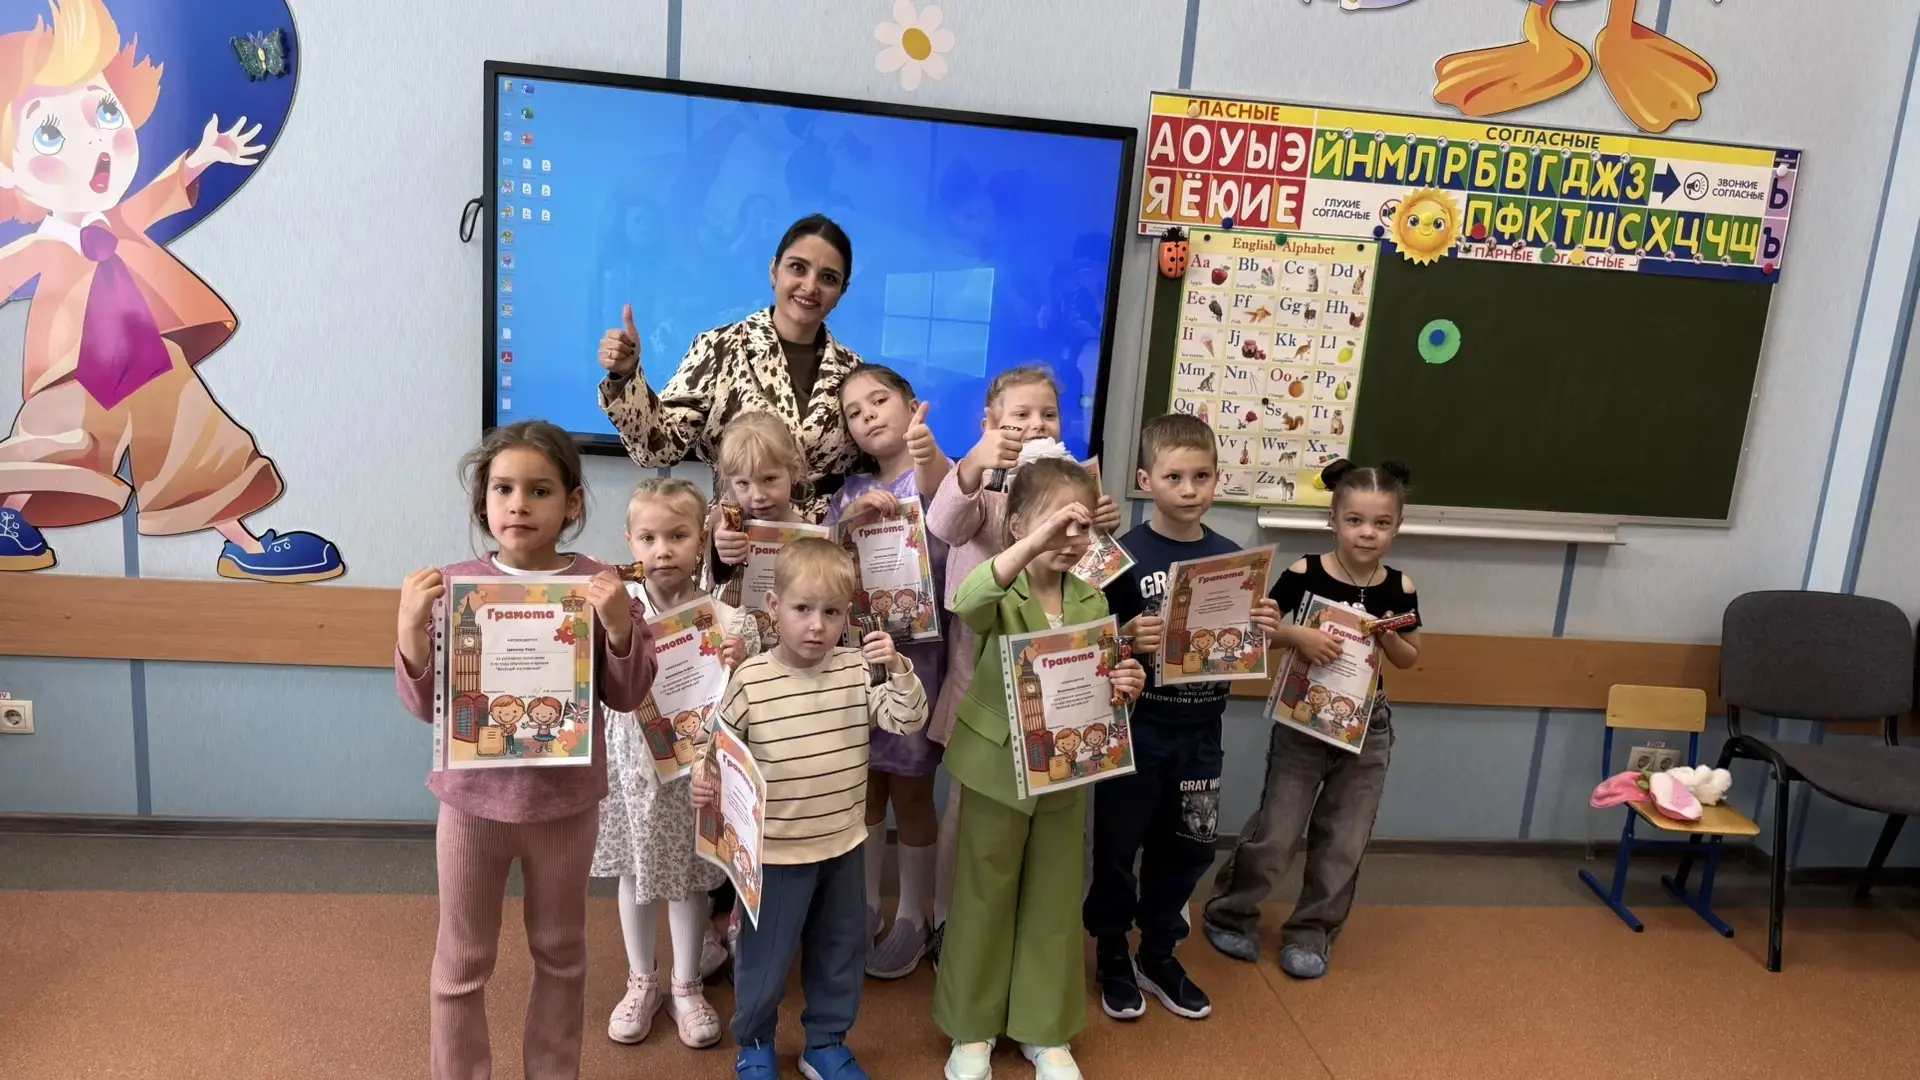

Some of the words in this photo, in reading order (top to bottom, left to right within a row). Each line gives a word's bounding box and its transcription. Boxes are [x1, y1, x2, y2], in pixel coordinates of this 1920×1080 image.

[1187, 99, 1280, 121] ГЛАСНЫЕ
[1486, 127, 1600, 149] СОГЛАСНЫЕ
[1717, 179, 1759, 190] ЗВОНКИЕ
[1712, 188, 1765, 200] СОГЛАСНЫЕ
[1768, 177, 1789, 209] Ь
[1325, 198, 1361, 209] ГЛУХИЕ
[1312, 208, 1371, 220] СОГЛАСНЫЕ
[1232, 237, 1276, 253] English
[1282, 241, 1335, 256] Alphabet
[1763, 227, 1781, 259] Ъ
[1190, 253, 1210, 268] Aa
[1237, 256, 1259, 272] Bb
[1474, 247, 1533, 262] ПАРНЫЕ
[1553, 253, 1625, 269] ОГСНЫЕ
[1284, 260, 1304, 274] Cc
[1330, 263, 1354, 278] Dd
[1186, 290, 1206, 305] Ee
[1233, 294, 1252, 308] Ff
[1280, 297, 1302, 316] Gg
[1325, 300, 1349, 314] Hh
[1182, 327, 1194, 340] Ii
[1228, 330, 1241, 347] Jj
[1274, 332, 1297, 347] Kk
[1320, 335, 1336, 349] Ll
[1178, 362, 1206, 376] Mm
[1224, 365, 1247, 379] Nn
[1270, 368, 1292, 382] Oo
[1315, 370, 1336, 388] Pp
[1174, 397, 1194, 415] Qq
[1221, 400, 1241, 413] Rr
[1265, 403, 1282, 416] Ss
[1311, 405, 1329, 419] Tt
[1217, 434, 1237, 448] Vv
[1261, 437, 1288, 451] Ww
[1306, 439, 1327, 452] Xx
[1256, 470, 1275, 484] Zz
[858, 524, 905, 539] Грамота
[750, 544, 780, 556] Грамо
[1198, 570, 1245, 585] Грамота
[1140, 571, 1173, 599] GR
[487, 608, 555, 622] Грамота
[1327, 624, 1371, 647] Грамота
[655, 632, 694, 655] амота
[1041, 651, 1095, 669] Грамота
[1141, 691, 1192, 704] YELLOWSTONE
[1180, 779, 1208, 792] GRAY
